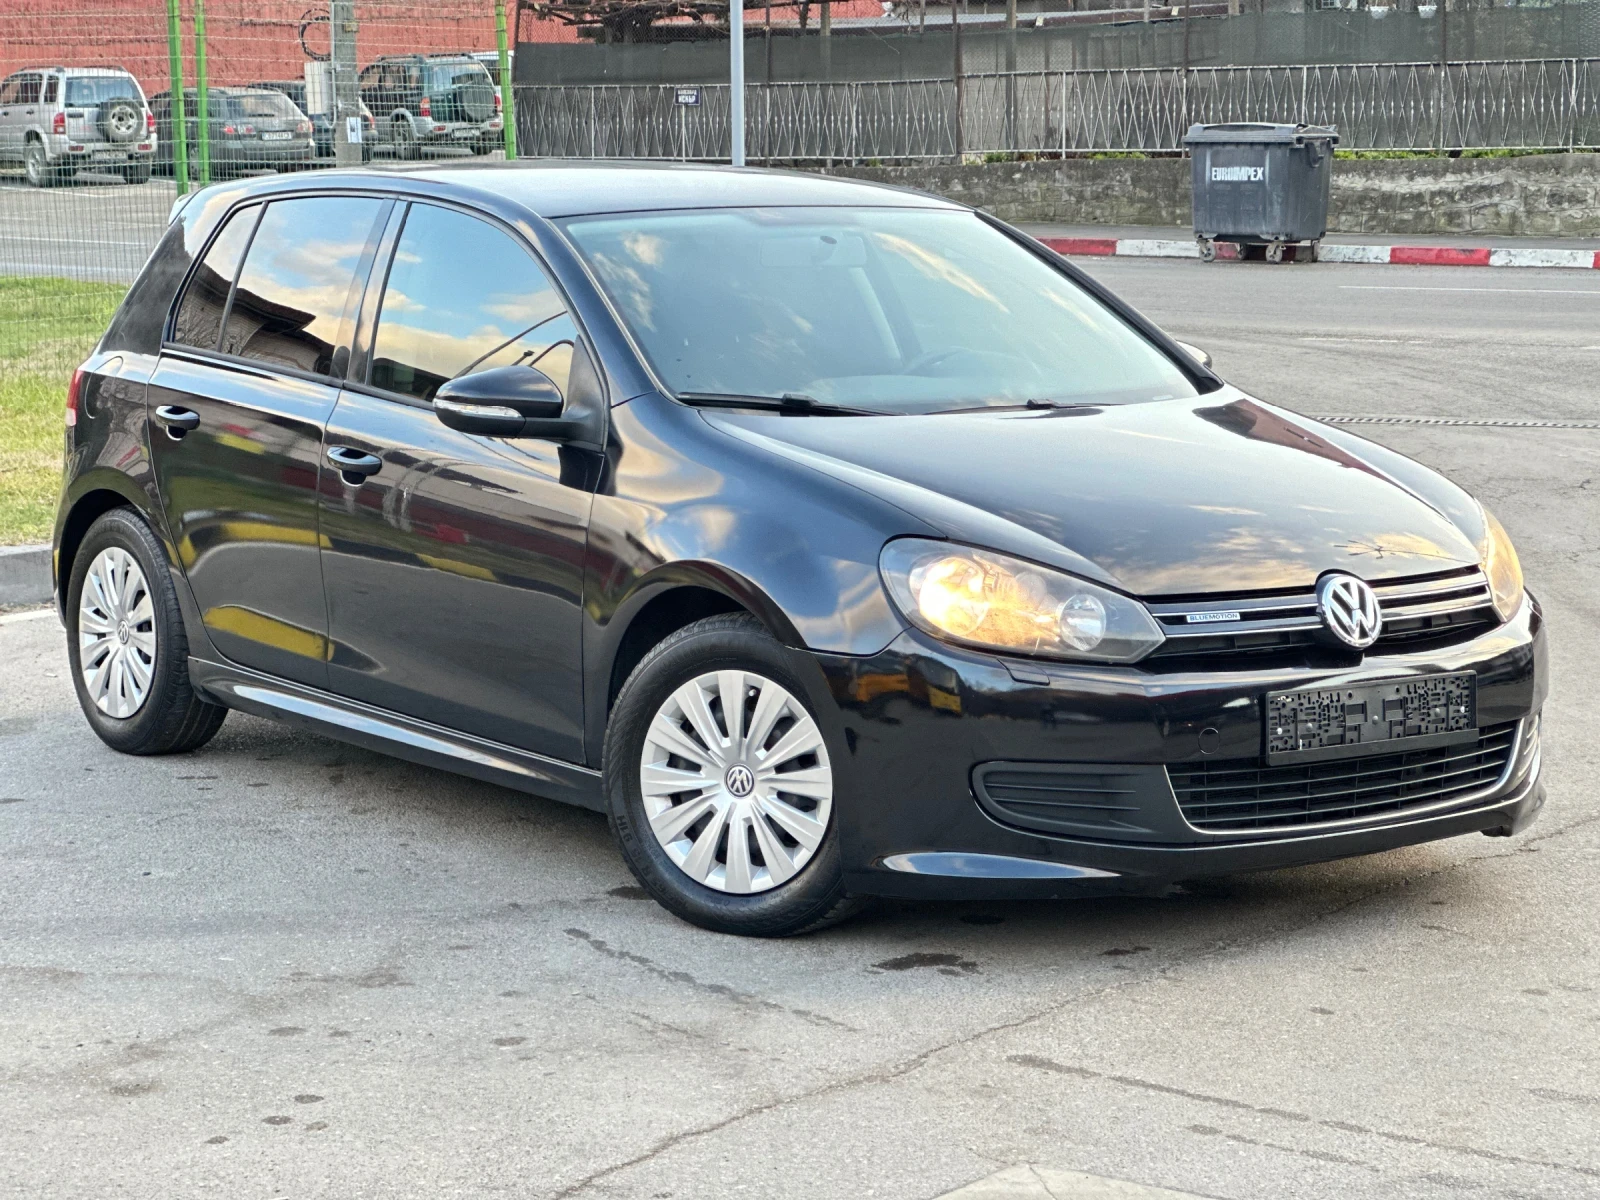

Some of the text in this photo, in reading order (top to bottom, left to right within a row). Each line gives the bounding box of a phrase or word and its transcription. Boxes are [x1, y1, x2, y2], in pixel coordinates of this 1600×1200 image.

[1211, 166, 1264, 181] EUROIMPEX
[1189, 613, 1238, 621] BLUEMOTION
[1323, 577, 1381, 645] VW
